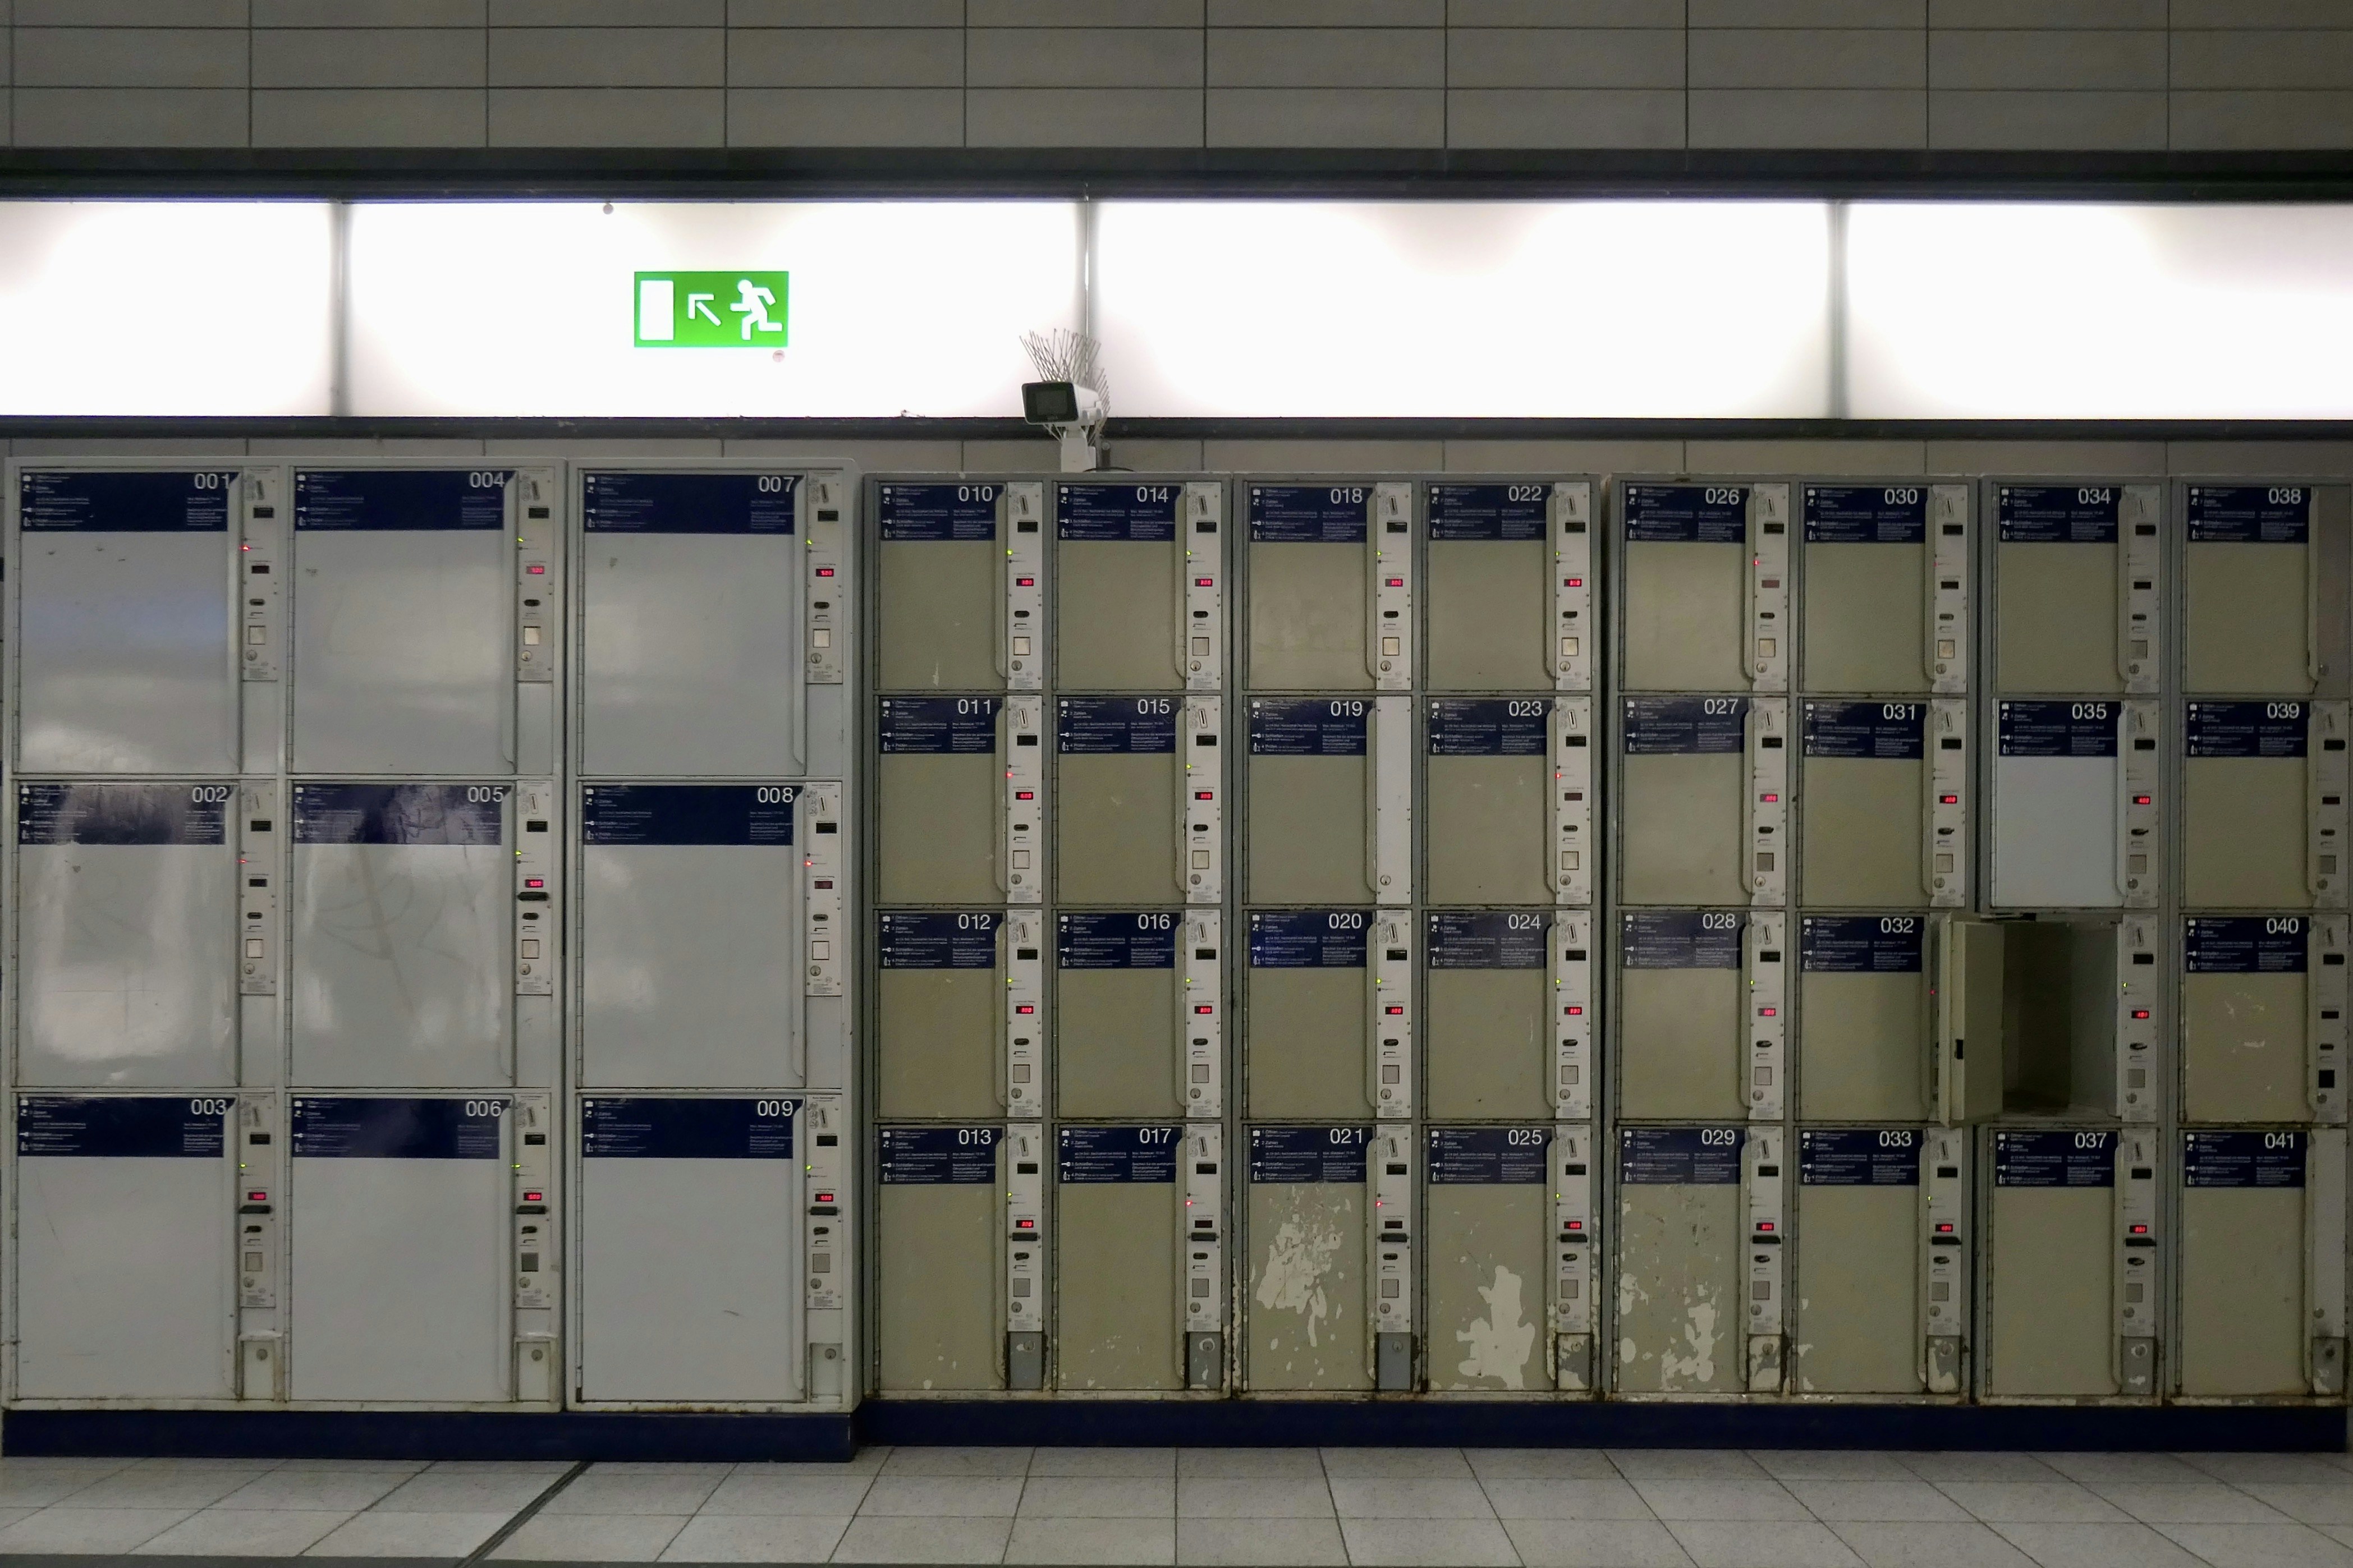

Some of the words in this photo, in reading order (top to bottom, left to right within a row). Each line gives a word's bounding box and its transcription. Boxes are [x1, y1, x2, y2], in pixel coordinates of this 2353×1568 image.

[194, 473, 231, 489] 001
[470, 472, 506, 488] 004
[759, 476, 795, 493] 007
[958, 486, 993, 502] 010
[1136, 486, 1168, 503] 014
[1331, 488, 1363, 504] 018
[1508, 485, 1542, 502] 022
[1705, 488, 1739, 505] 026
[1884, 488, 1918, 505] 030
[2078, 488, 2111, 504] 034
[2268, 488, 2301, 504] 038
[958, 698, 990, 714] 011
[1137, 698, 1170, 714] 015
[1331, 701, 1363, 717] 019
[1508, 701, 1542, 716] 023
[1704, 698, 1739, 715] 027
[1883, 703, 1915, 720] 031
[2072, 703, 2107, 720] 035
[2267, 702, 2300, 719] 039
[192, 787, 227, 803] 002
[467, 787, 503, 803] 005
[758, 787, 793, 803] 008
[958, 914, 990, 930] 012
[1137, 914, 1170, 930] 016
[1328, 913, 1362, 929] 020
[1508, 914, 1541, 930] 024
[1703, 913, 1736, 929] 028
[1880, 917, 1914, 933] 032
[2266, 918, 2299, 934] 040
[191, 1099, 227, 1115] 003
[466, 1101, 502, 1116] 006
[757, 1100, 793, 1116] 009
[958, 1129, 991, 1145] 013
[1139, 1128, 1172, 1144] 017
[1330, 1128, 1362, 1144] 021
[1508, 1129, 1542, 1145] 025
[1701, 1129, 1735, 1145] 029
[1879, 1131, 1912, 1147] 033
[2075, 1132, 2107, 1148] 037
[2265, 1133, 2294, 1149] 041
